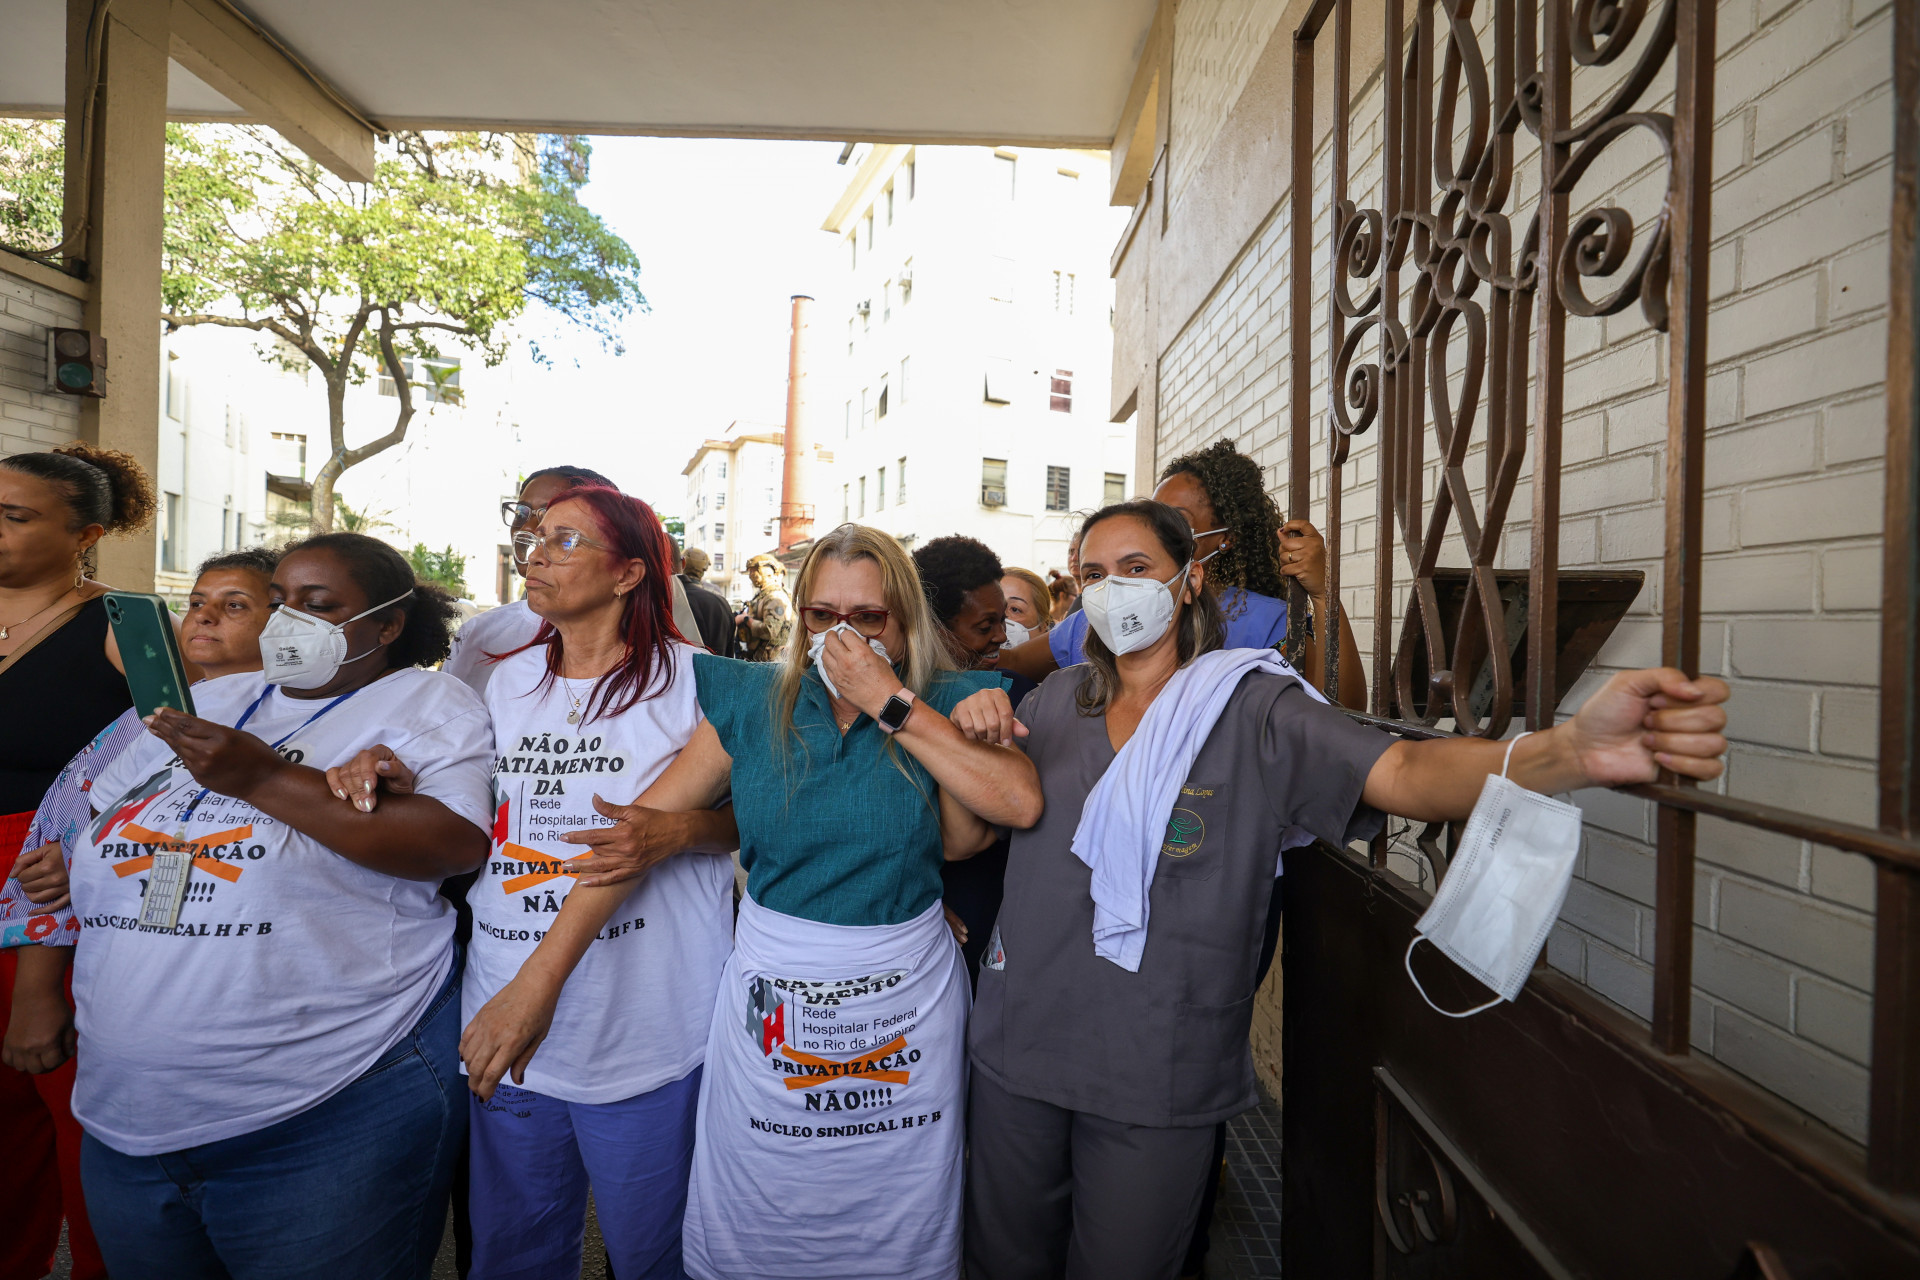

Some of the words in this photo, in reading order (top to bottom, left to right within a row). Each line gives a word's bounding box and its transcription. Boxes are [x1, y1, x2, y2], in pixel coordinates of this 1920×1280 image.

[518, 733, 569, 754] NÃO
[574, 736, 602, 753] AO
[534, 779, 564, 795] DA
[530, 799, 561, 809] Rede
[197, 811, 215, 822] de
[218, 813, 274, 825] Janeiro
[529, 814, 588, 827] Hospitalar
[529, 832, 544, 841] no
[522, 890, 568, 912] NÃ
[478, 921, 530, 941] NÚCLEO
[802, 1006, 836, 1019] Rede
[802, 1022, 869, 1036] Hospitalar
[874, 1007, 917, 1029] Federal
[804, 1039, 819, 1049] no
[824, 1039, 845, 1050] Rio
[850, 1037, 866, 1048] de
[871, 1023, 916, 1047] Janeiro
[772, 1049, 922, 1076] PRIVATIZAÇÃO
[804, 1087, 892, 1112] NÃO!!!!
[750, 1118, 813, 1137] NÚCLEO
[816, 1119, 898, 1138] SINDICAL
